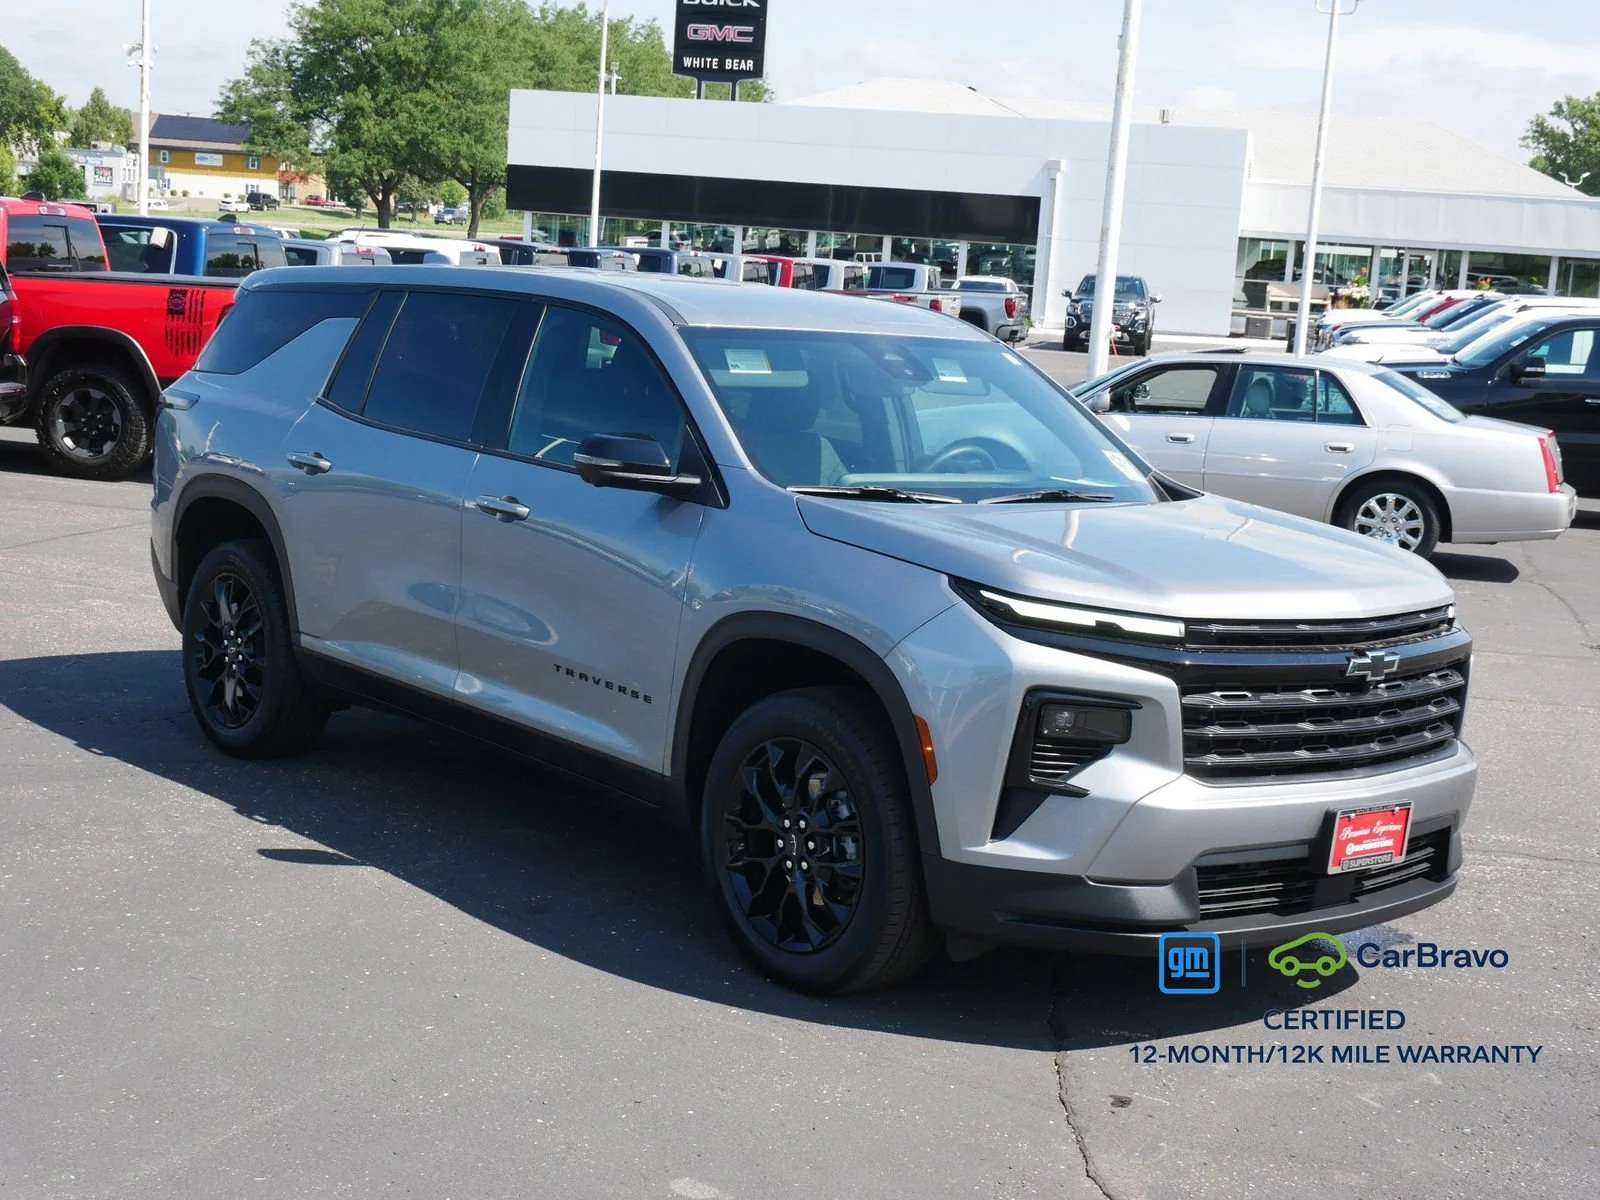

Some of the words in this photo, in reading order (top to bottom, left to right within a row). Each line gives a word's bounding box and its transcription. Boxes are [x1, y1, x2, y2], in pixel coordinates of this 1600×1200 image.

[687, 23, 754, 43] GMC
[683, 56, 718, 69] WHITE
[725, 58, 753, 71] BEAR
[553, 663, 652, 704] TRAVERSE
